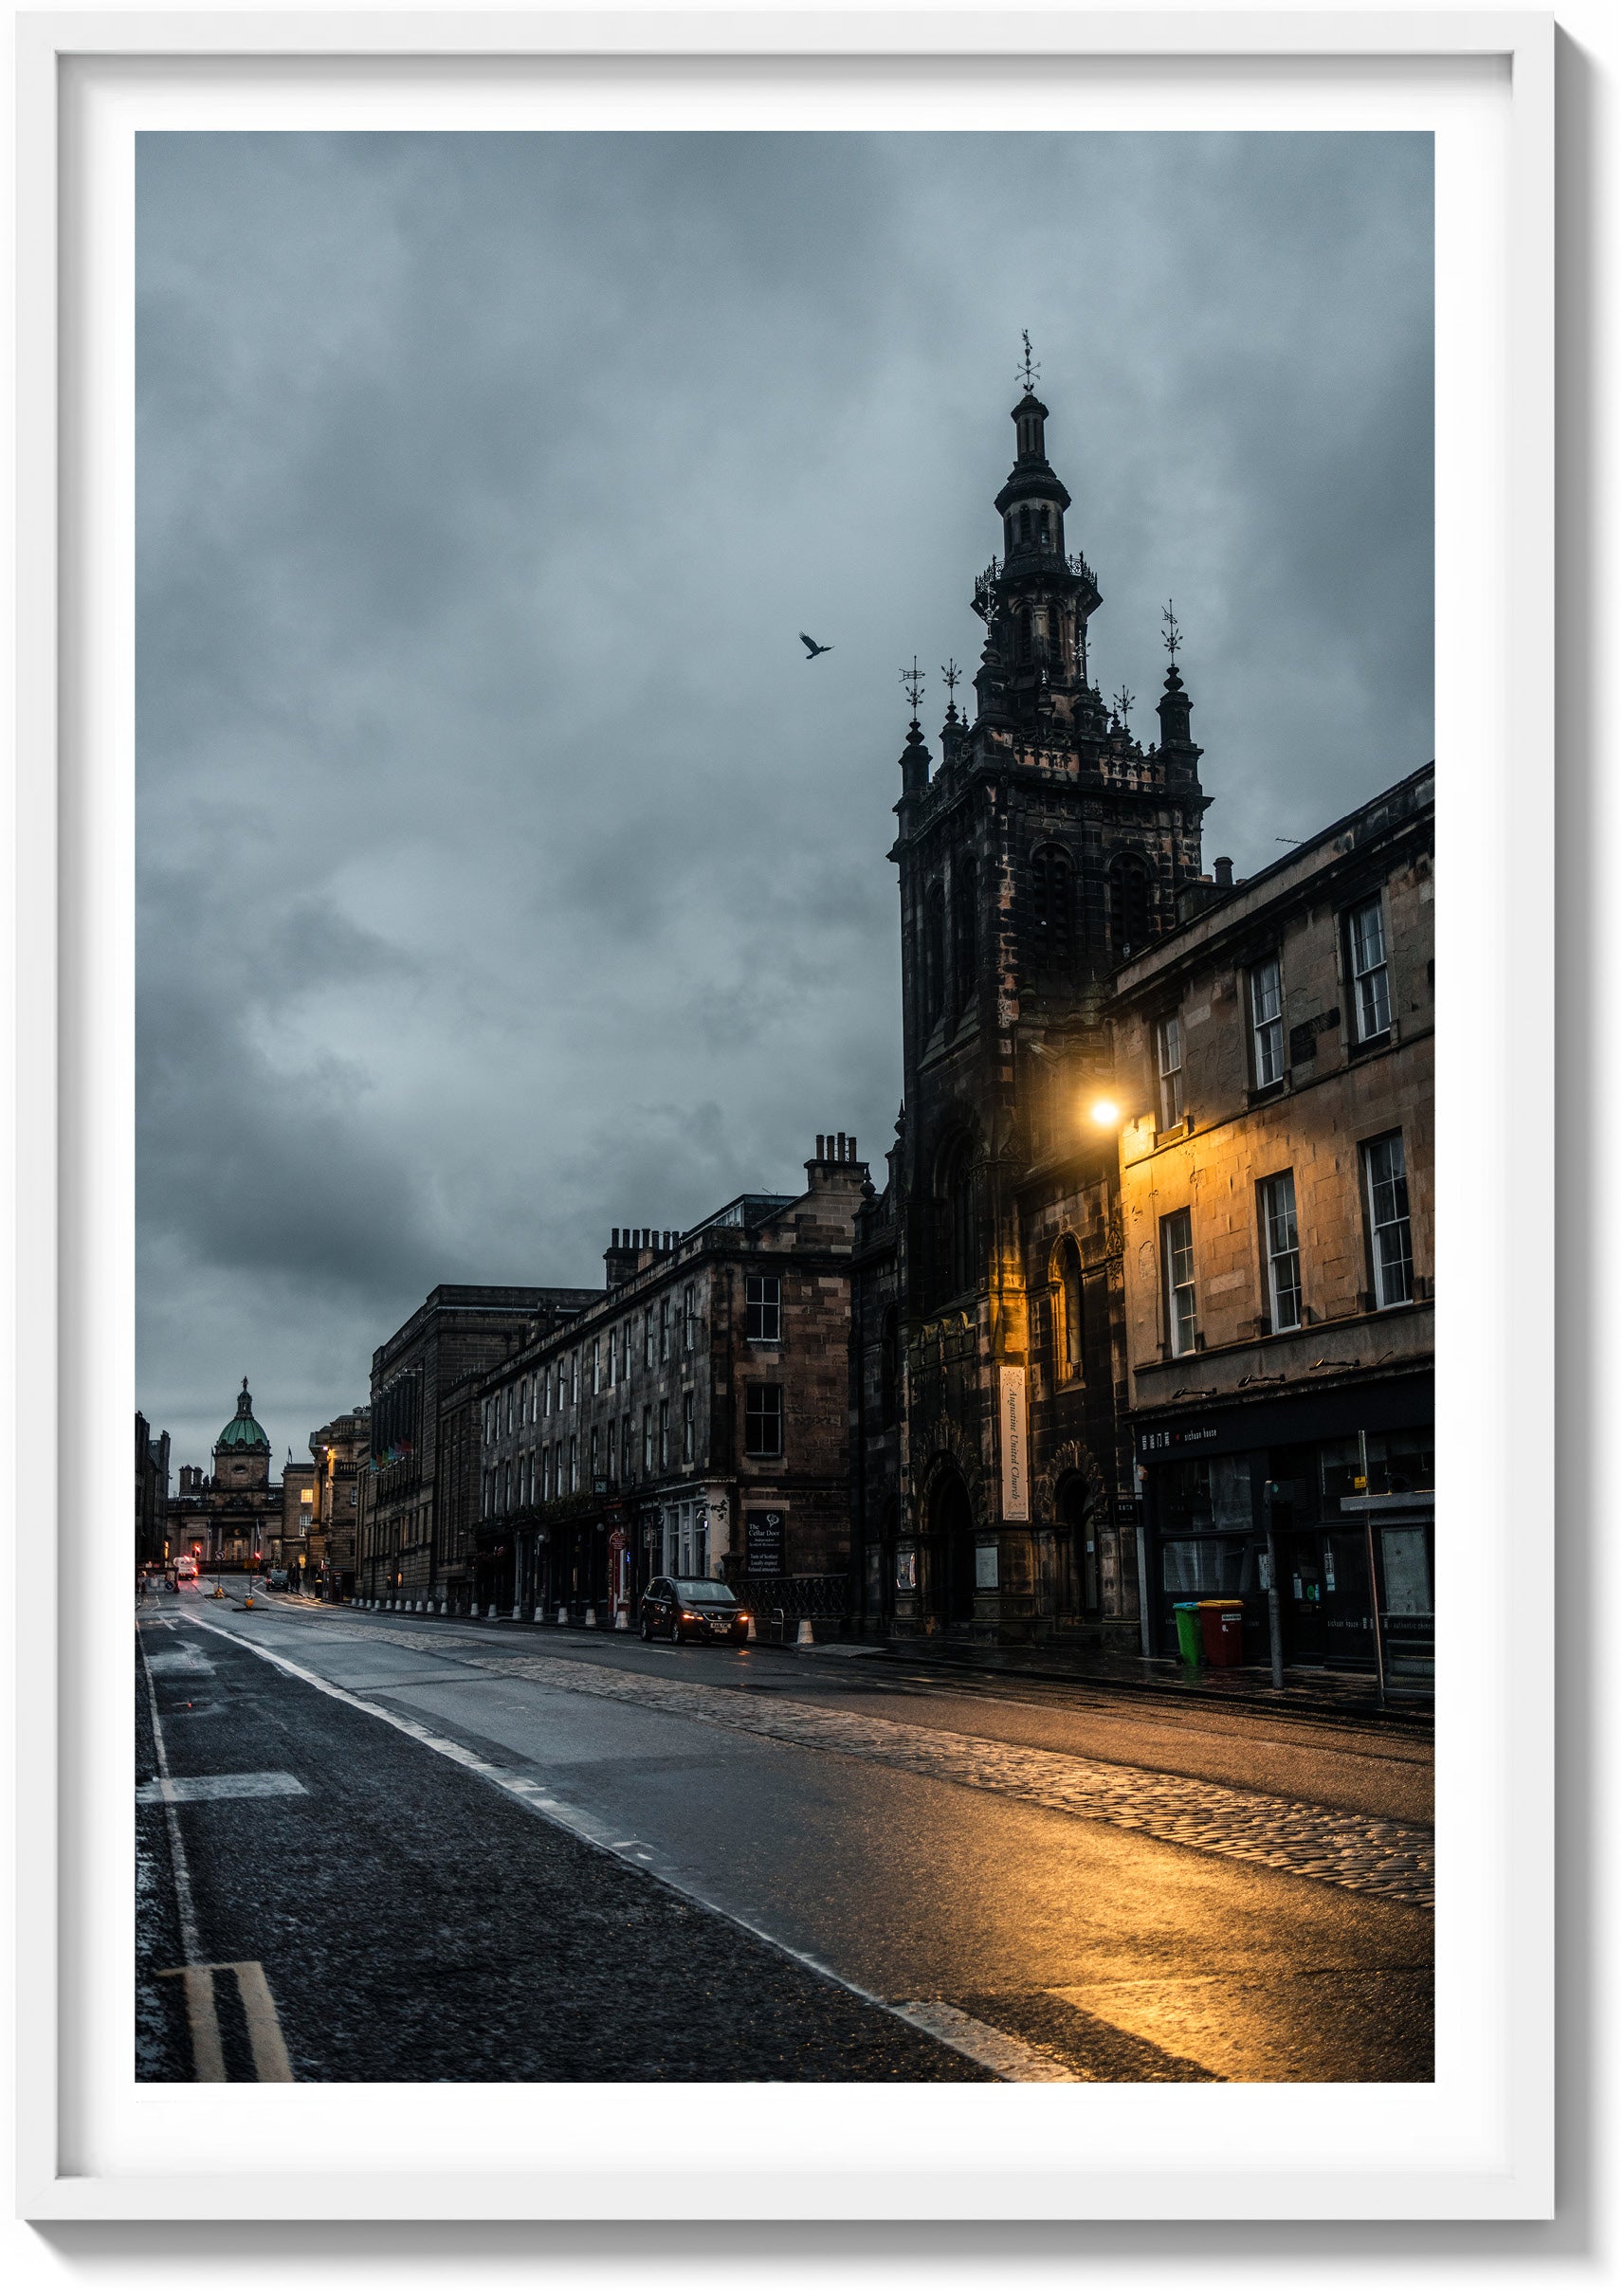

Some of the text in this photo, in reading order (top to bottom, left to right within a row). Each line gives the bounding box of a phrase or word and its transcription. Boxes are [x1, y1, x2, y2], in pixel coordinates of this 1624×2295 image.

[1007, 1389, 1016, 1432] Augustine
[1011, 1434, 1020, 1465] United
[1011, 1466, 1020, 1500] Church
